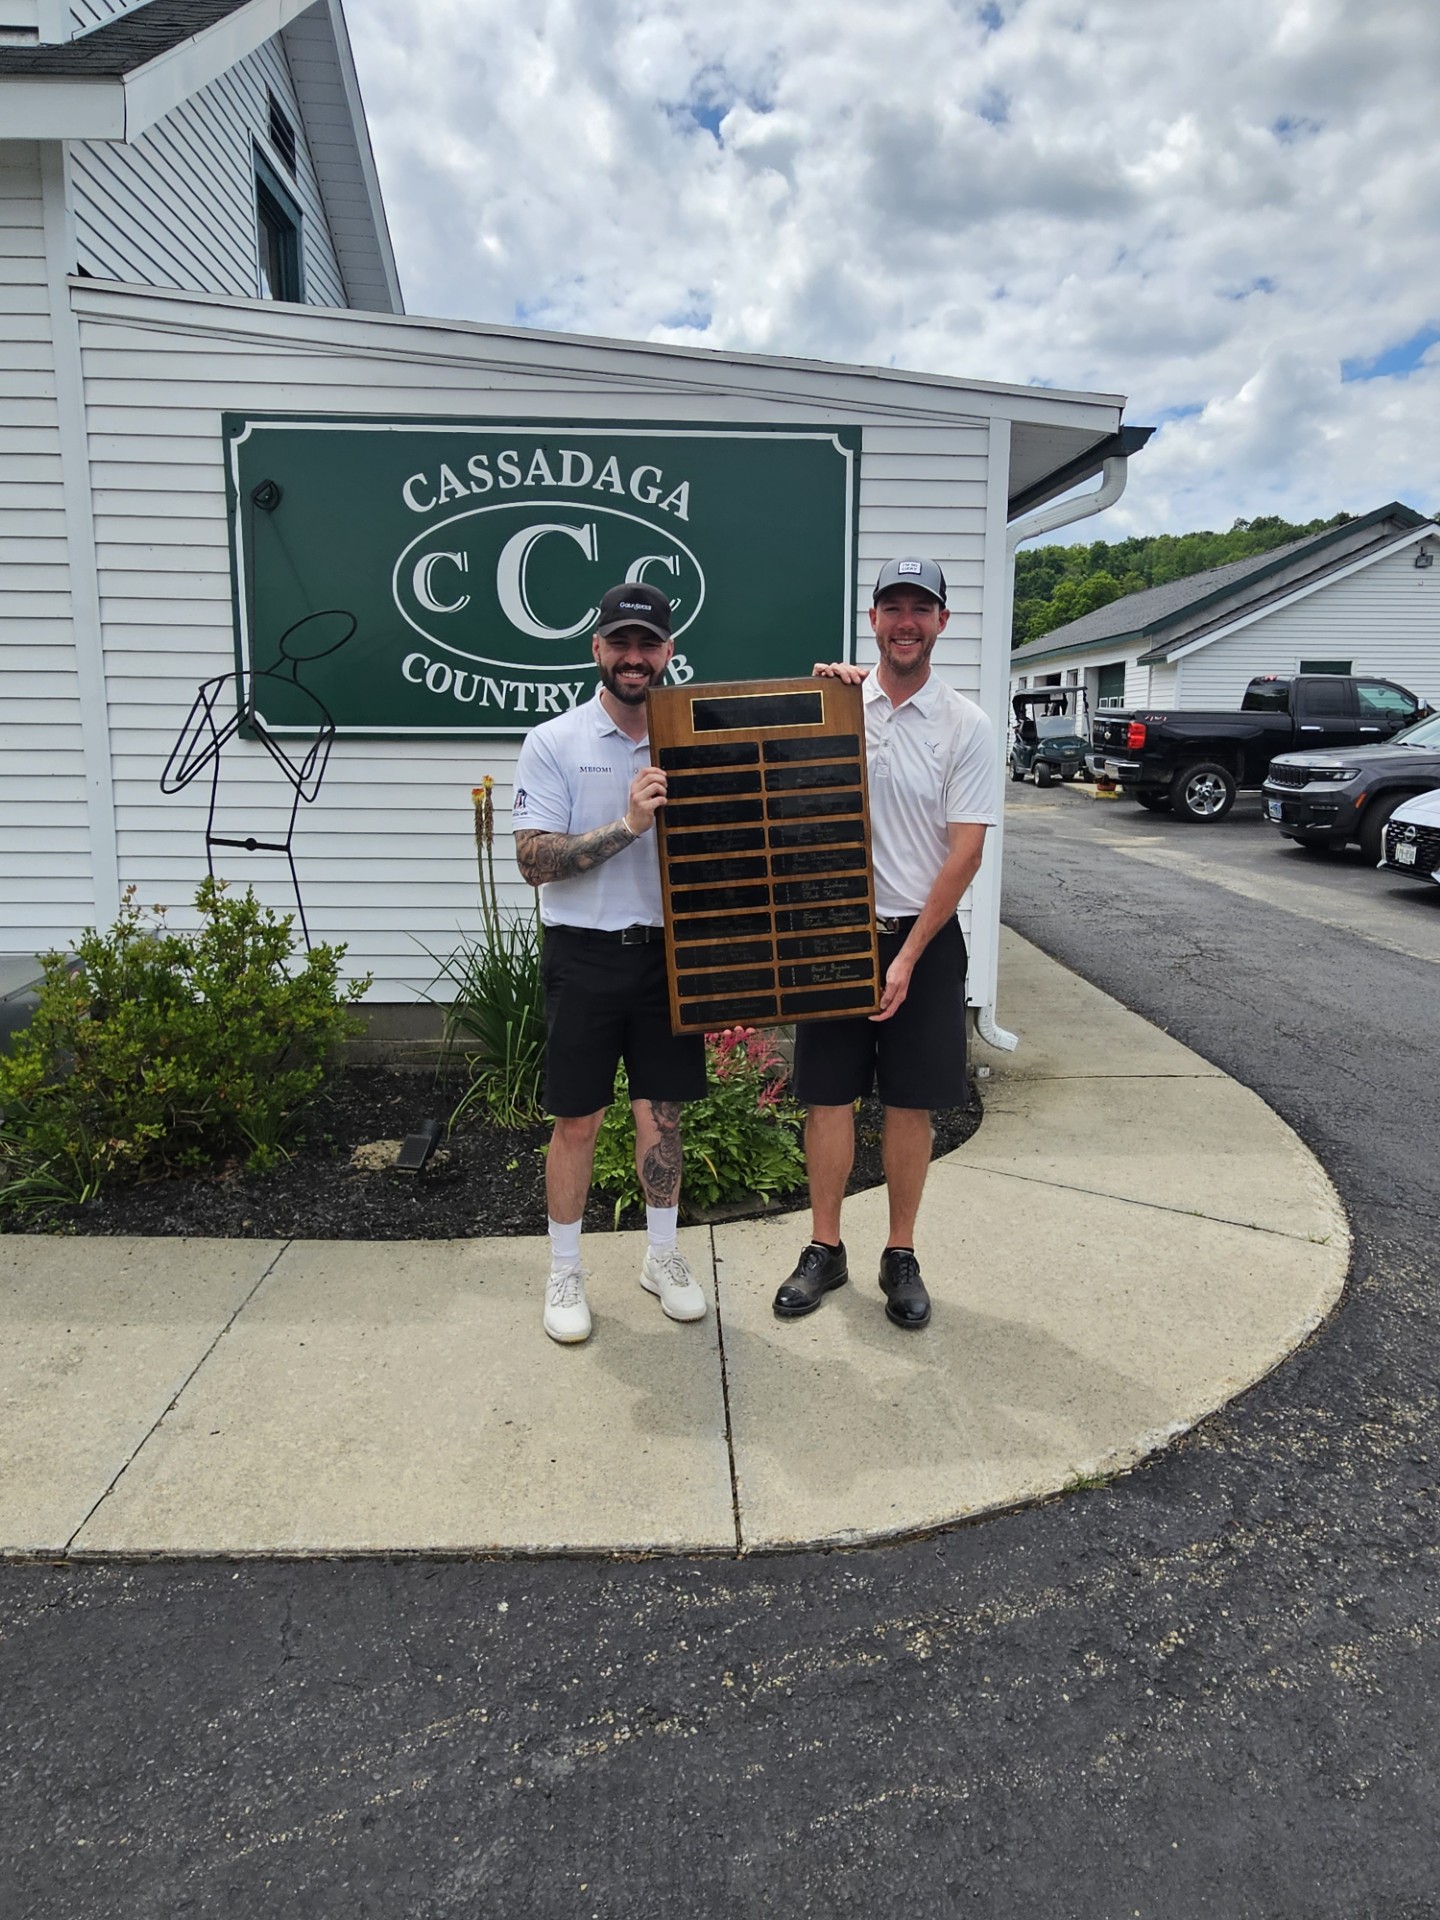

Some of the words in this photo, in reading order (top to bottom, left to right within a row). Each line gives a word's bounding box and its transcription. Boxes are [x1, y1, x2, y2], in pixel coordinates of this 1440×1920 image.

[402, 449, 690, 521] CASSADAGA
[413, 551, 470, 613] C
[496, 523, 600, 640] C
[401, 652, 585, 713] COUNTRY
